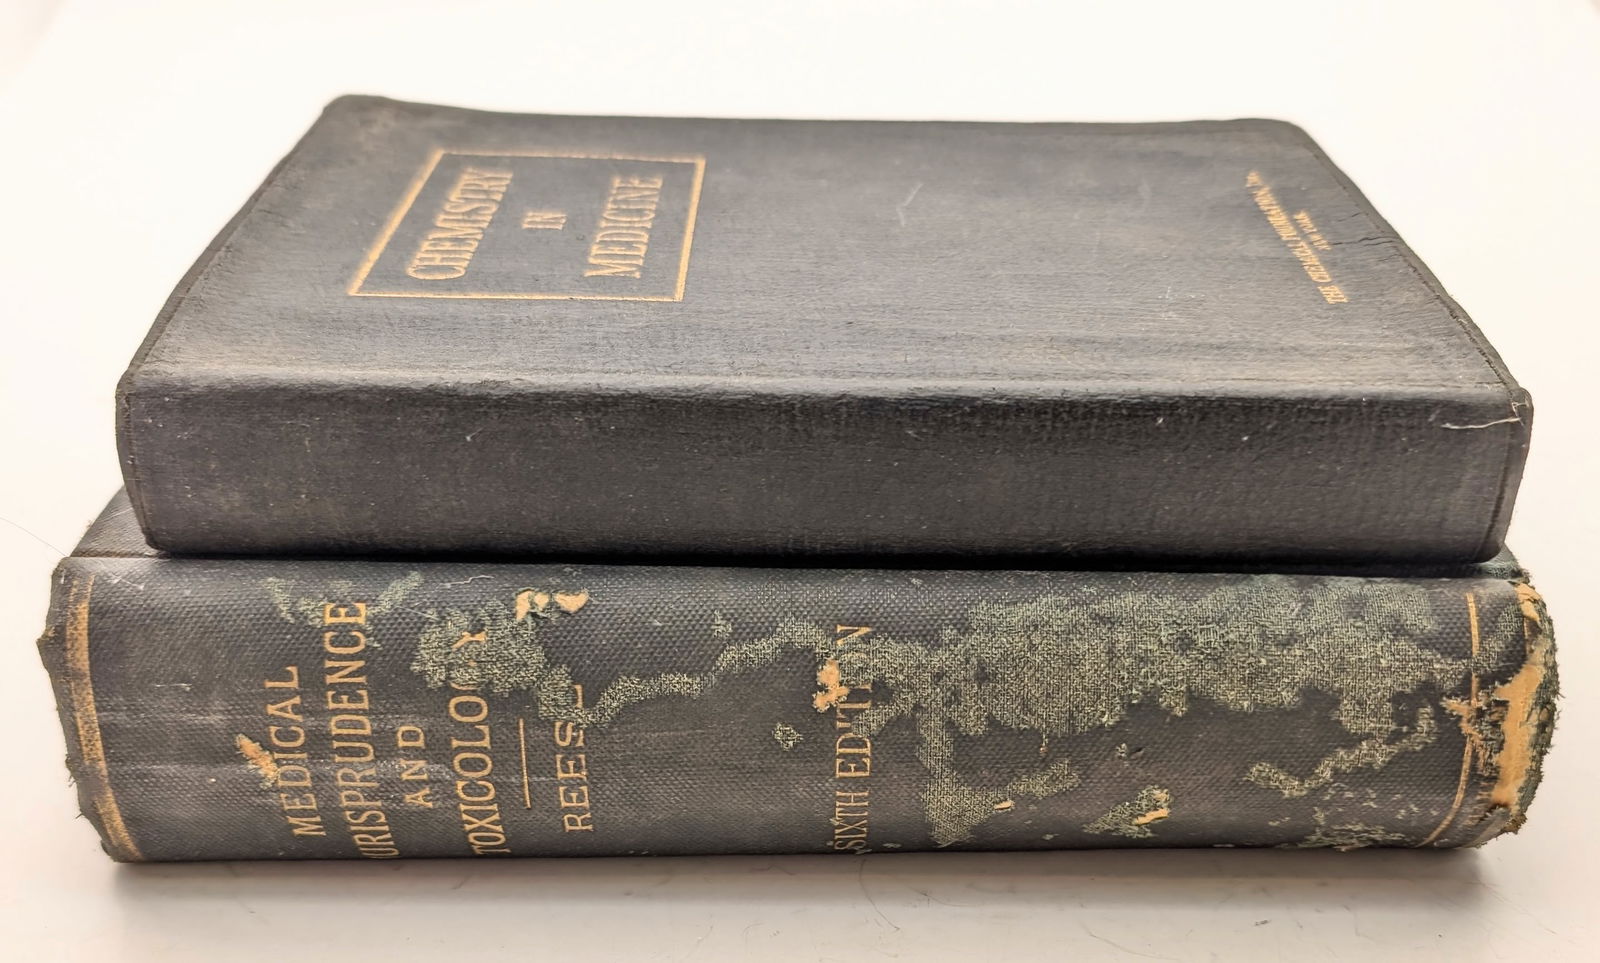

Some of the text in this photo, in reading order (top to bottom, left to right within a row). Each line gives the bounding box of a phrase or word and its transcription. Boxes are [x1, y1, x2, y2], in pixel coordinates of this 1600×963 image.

[406, 167, 513, 280] CHEMISTRY
[521, 210, 567, 230] IN
[583, 175, 663, 279] MEDICINE
[1317, 284, 1349, 305] THE
[264, 665, 327, 837] MEDICAL
[323, 601, 400, 860] URISPRUDENCE
[396, 724, 433, 809] AND
[448, 630, 512, 856] TOXICOLOY
[833, 791, 870, 850] SIXTH
